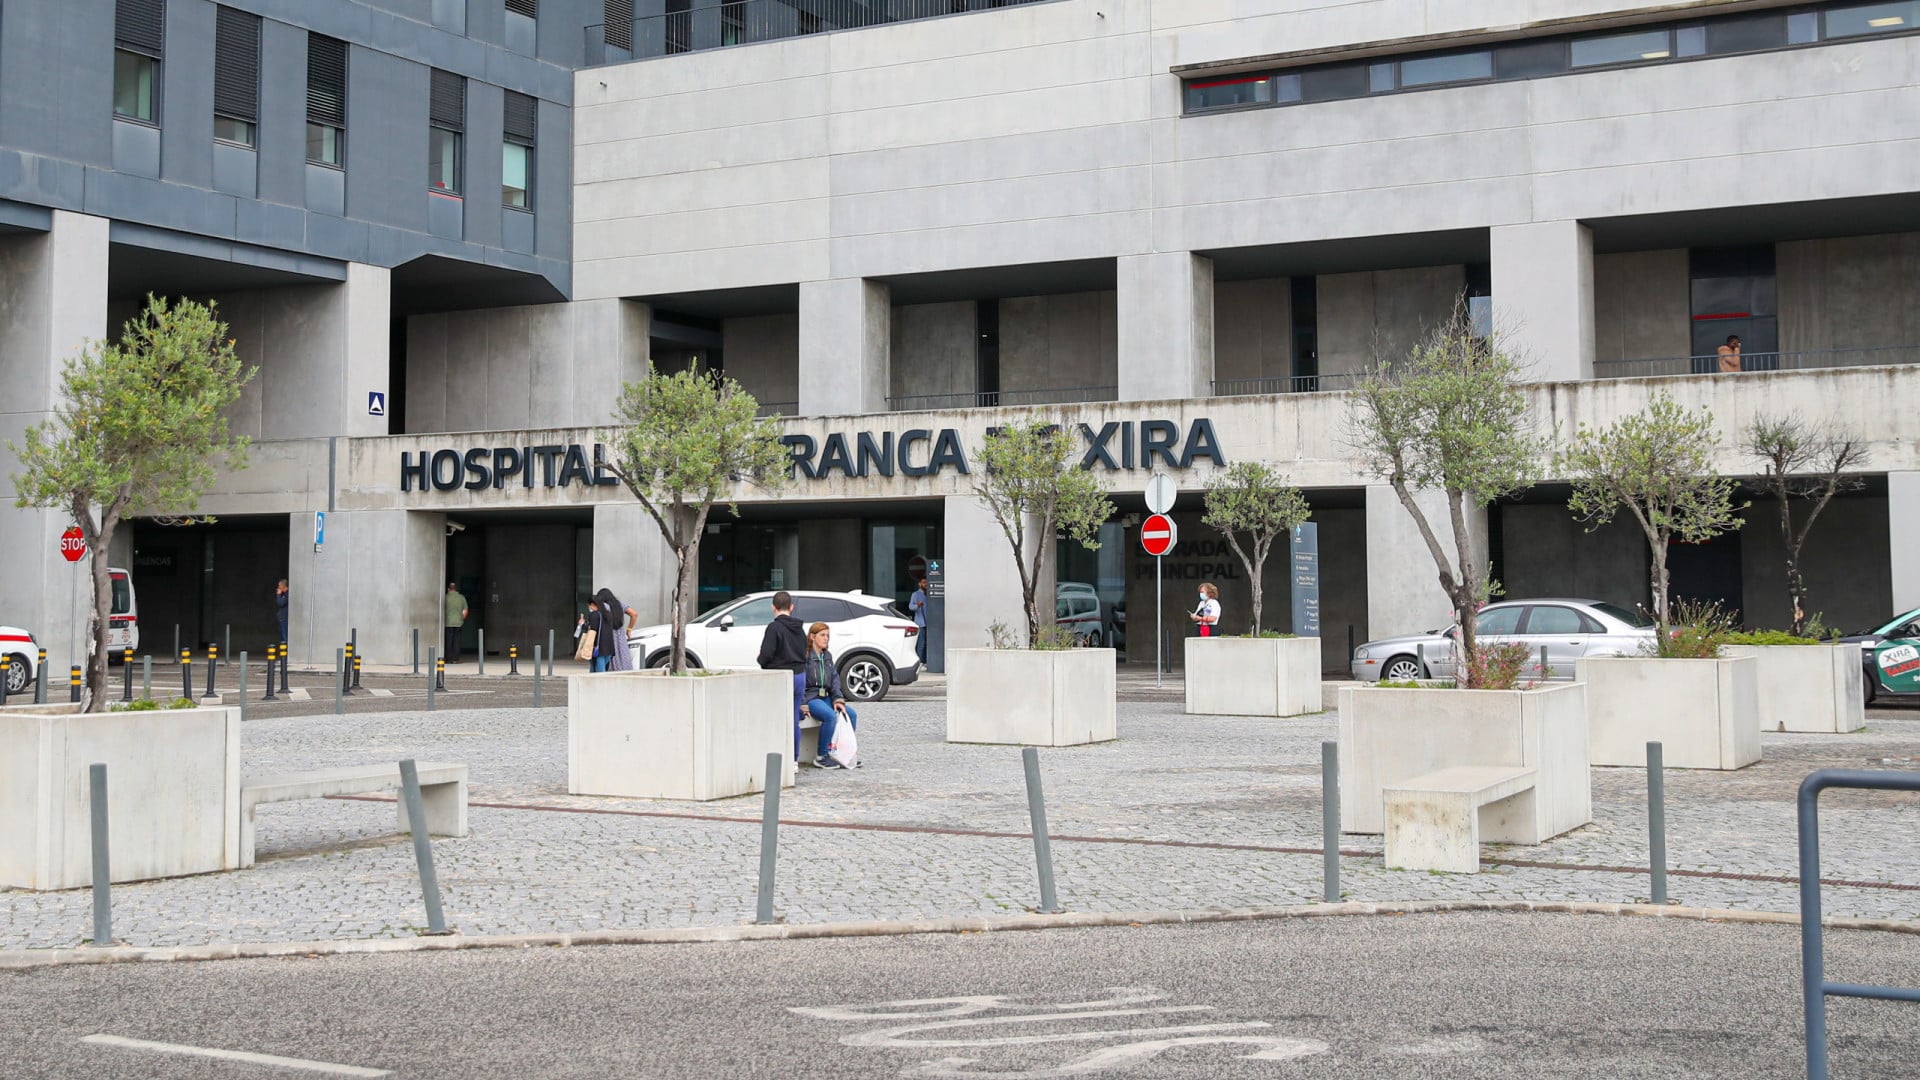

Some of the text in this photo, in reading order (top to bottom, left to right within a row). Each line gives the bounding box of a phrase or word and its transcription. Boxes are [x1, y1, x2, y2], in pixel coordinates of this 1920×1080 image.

[400, 443, 621, 492] HOSPITAL
[755, 428, 972, 480] RANCA
[1076, 418, 1228, 471] XIRA
[317, 515, 323, 541] P
[61, 537, 86, 551] STOP
[1136, 562, 1240, 579] PRINCIPAL
[1883, 648, 1911, 662] XIRA
